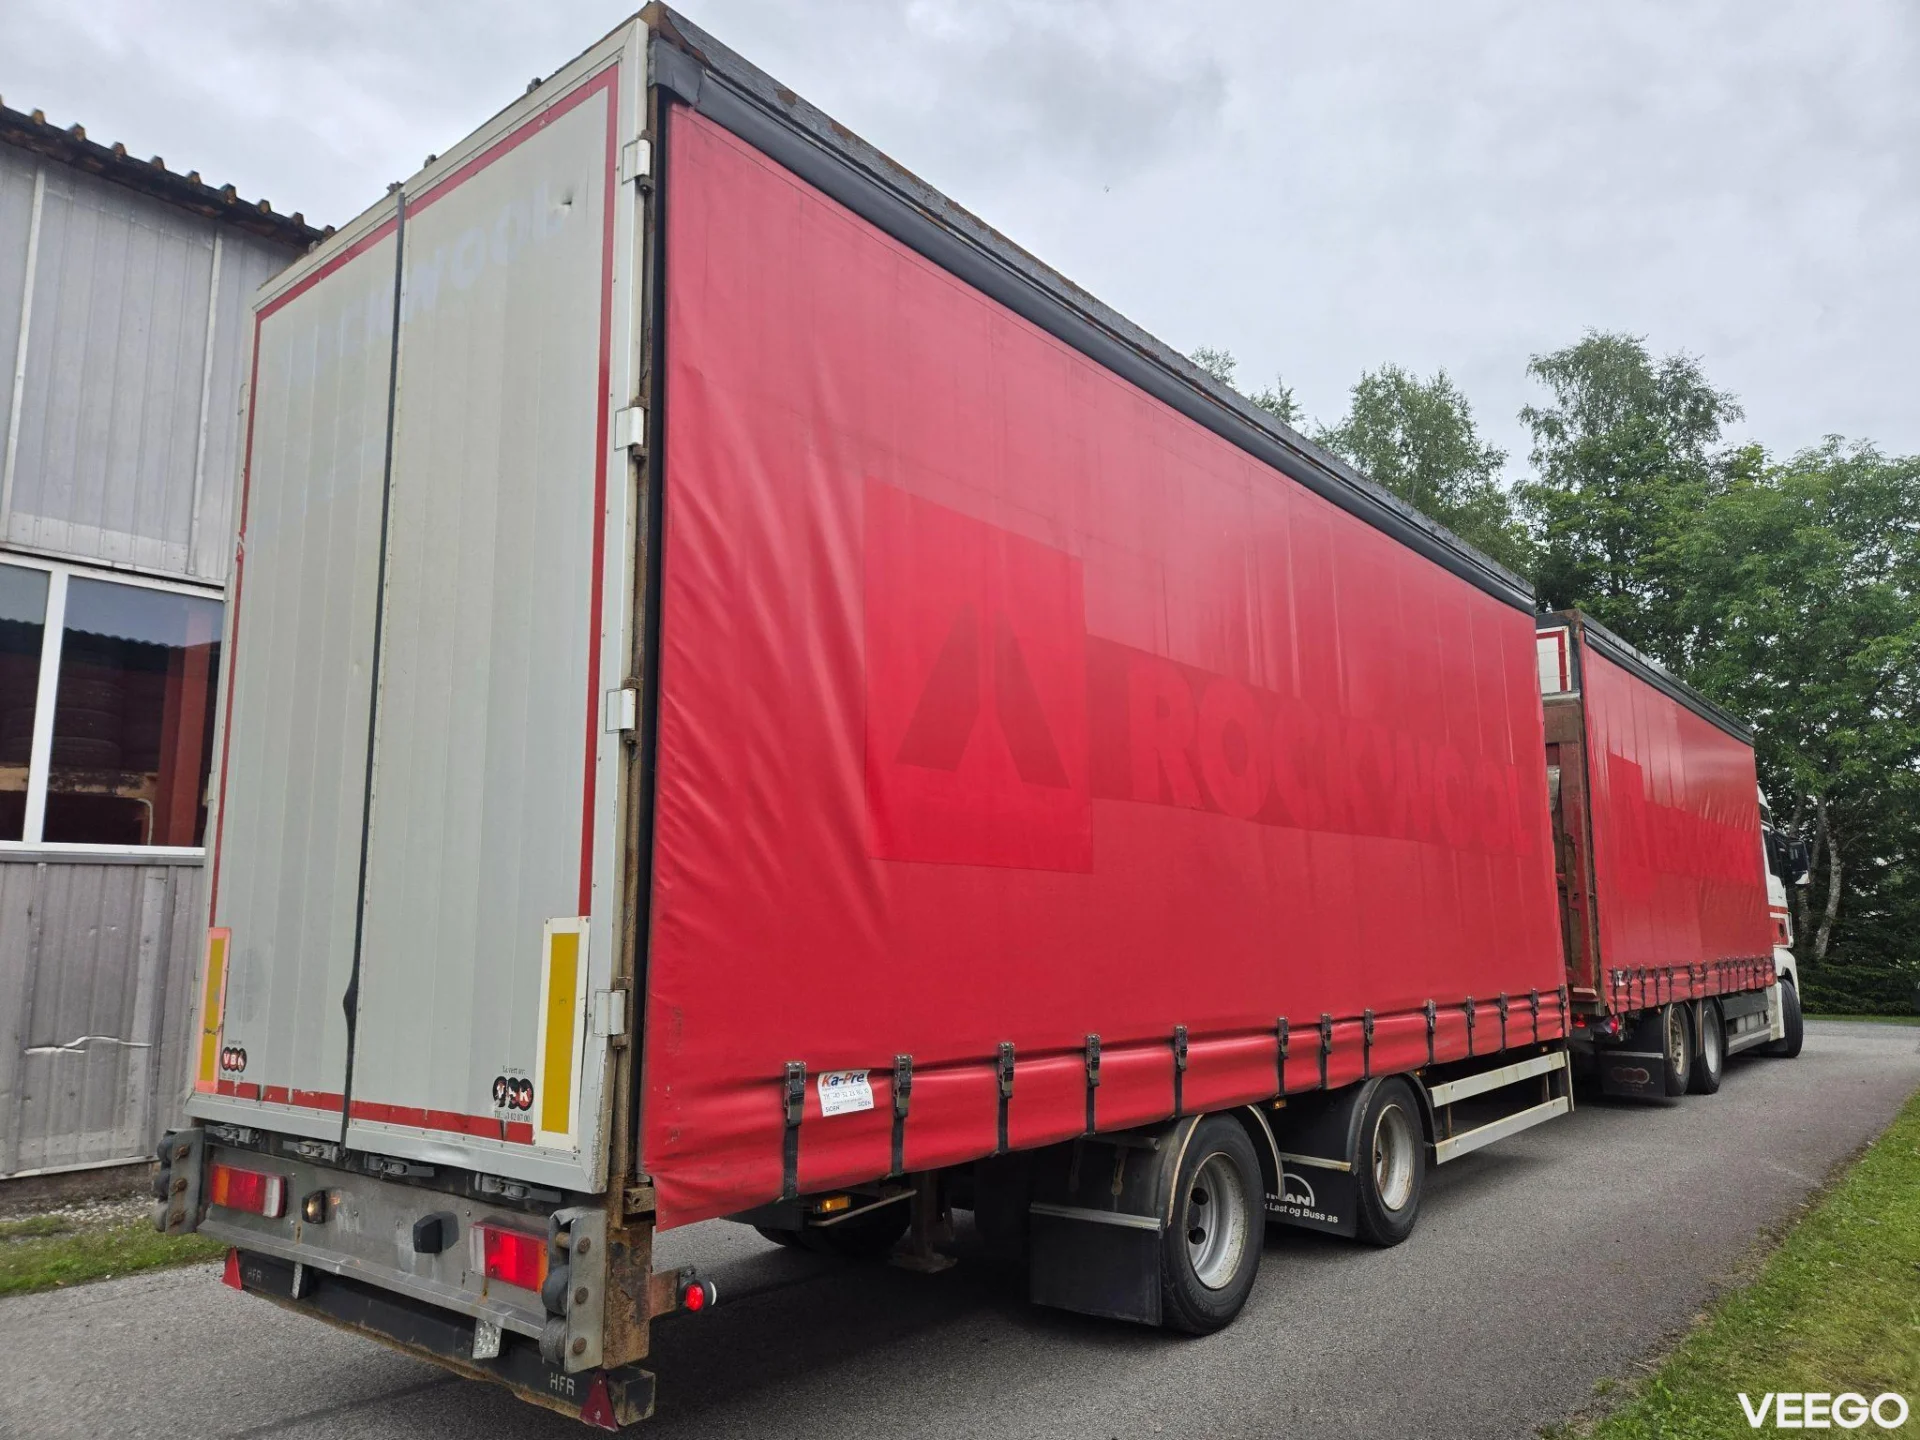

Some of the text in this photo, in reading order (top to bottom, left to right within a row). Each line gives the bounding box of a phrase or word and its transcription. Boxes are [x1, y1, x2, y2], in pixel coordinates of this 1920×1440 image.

[821, 1072, 865, 1087] Ka-Pre
[1269, 1203, 1287, 1212] Last
[1289, 1207, 1300, 1217] og
[1302, 1208, 1325, 1220] Buss
[1327, 1214, 1338, 1223] as
[550, 1372, 575, 1396] HFR
